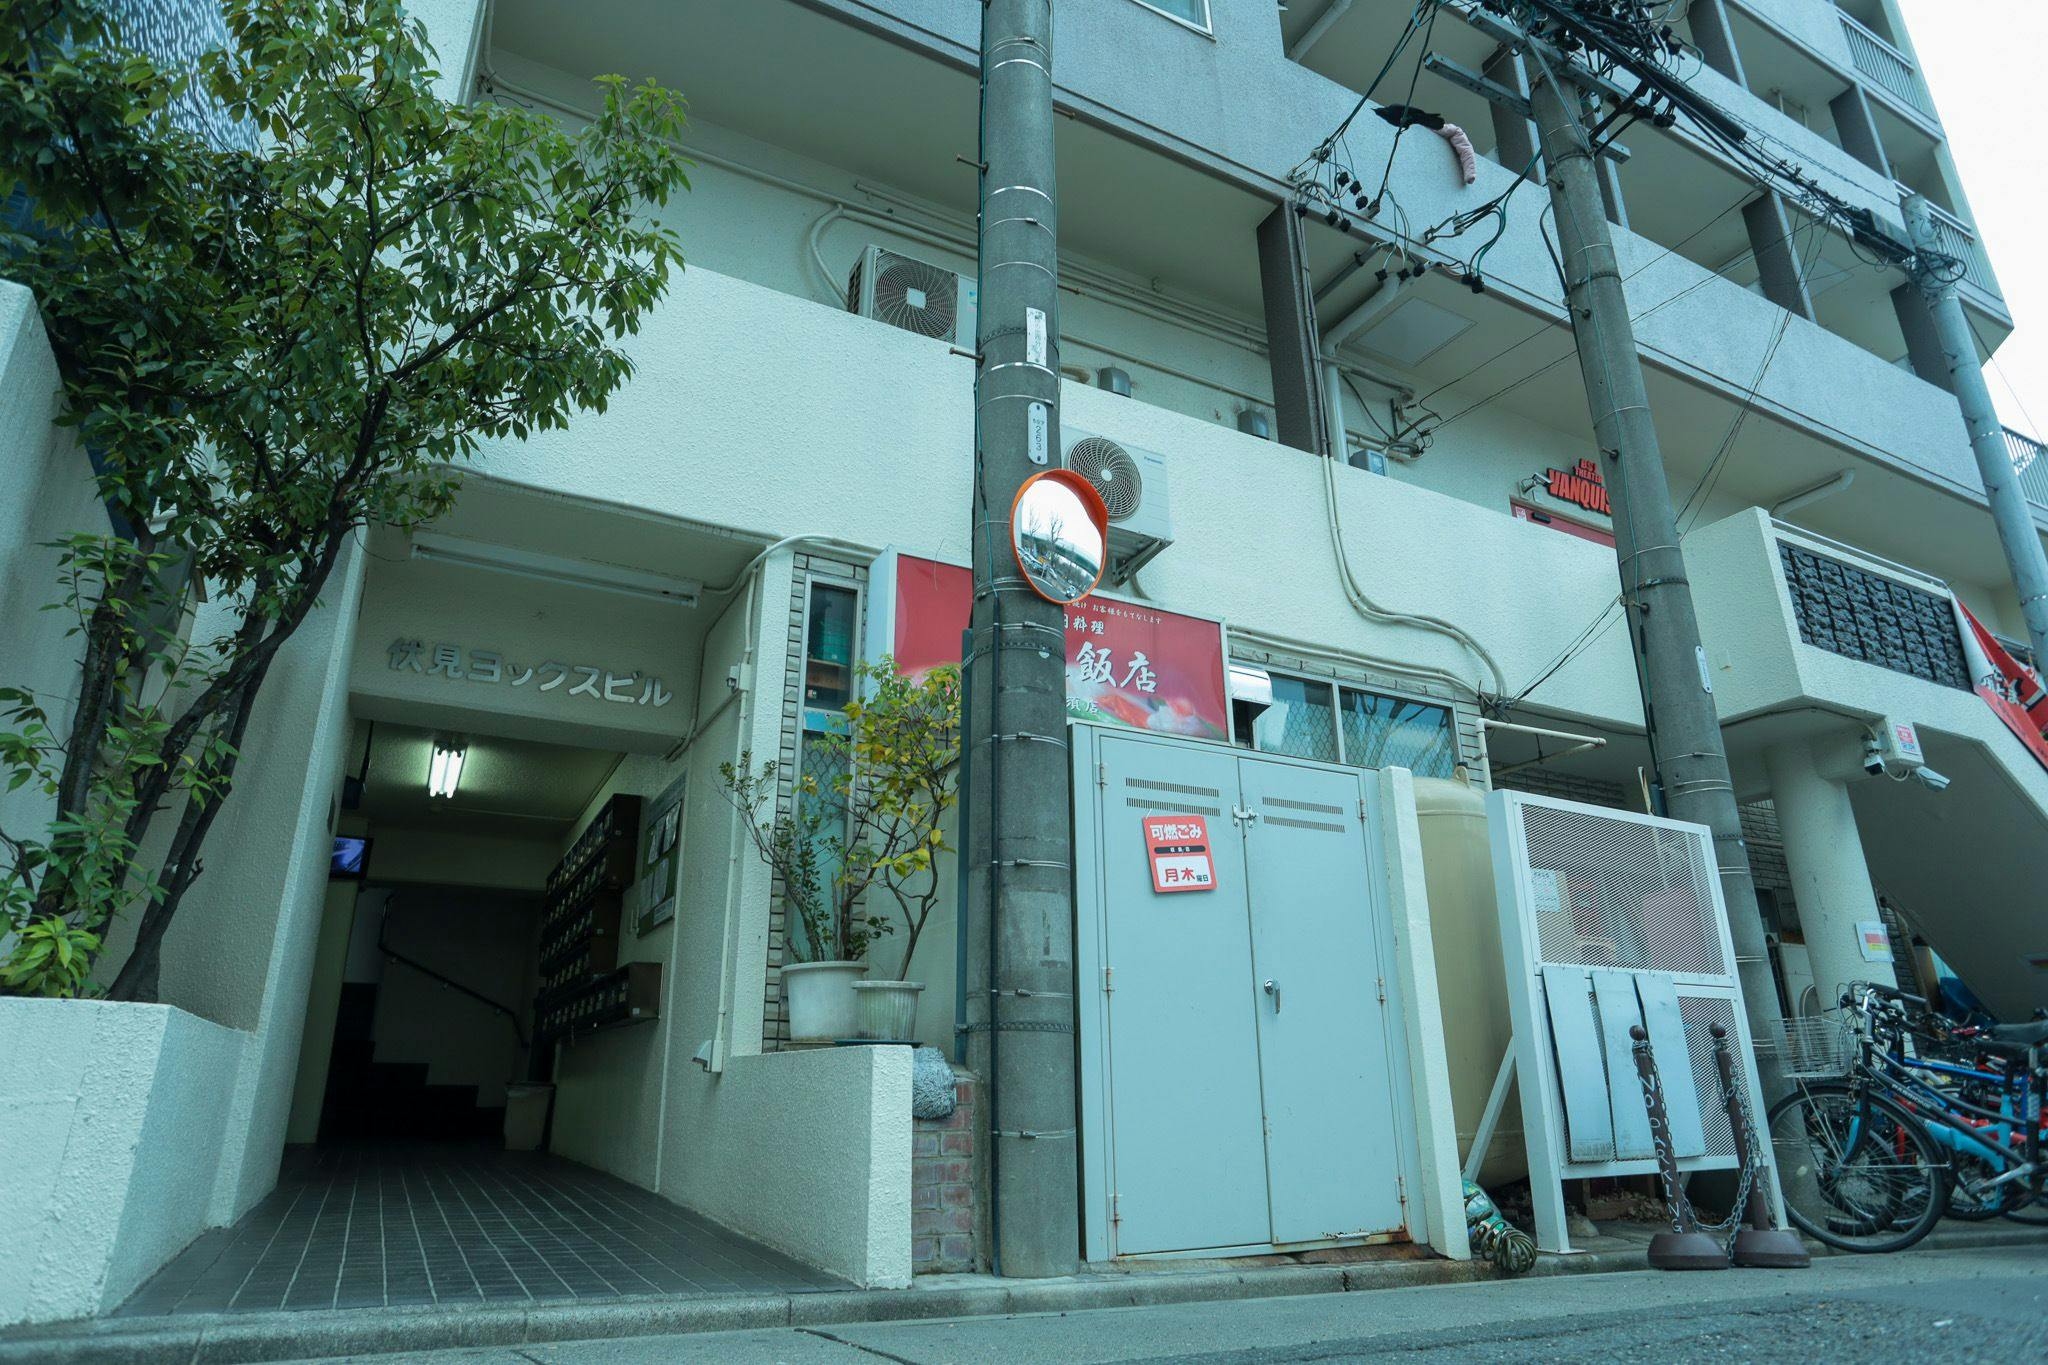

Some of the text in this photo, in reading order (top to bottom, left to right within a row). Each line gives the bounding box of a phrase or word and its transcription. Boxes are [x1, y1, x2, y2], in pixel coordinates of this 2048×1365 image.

[387, 638, 673, 707] 伏見ヨックスビル
[1149, 823, 1202, 841] 可燃ごみ
